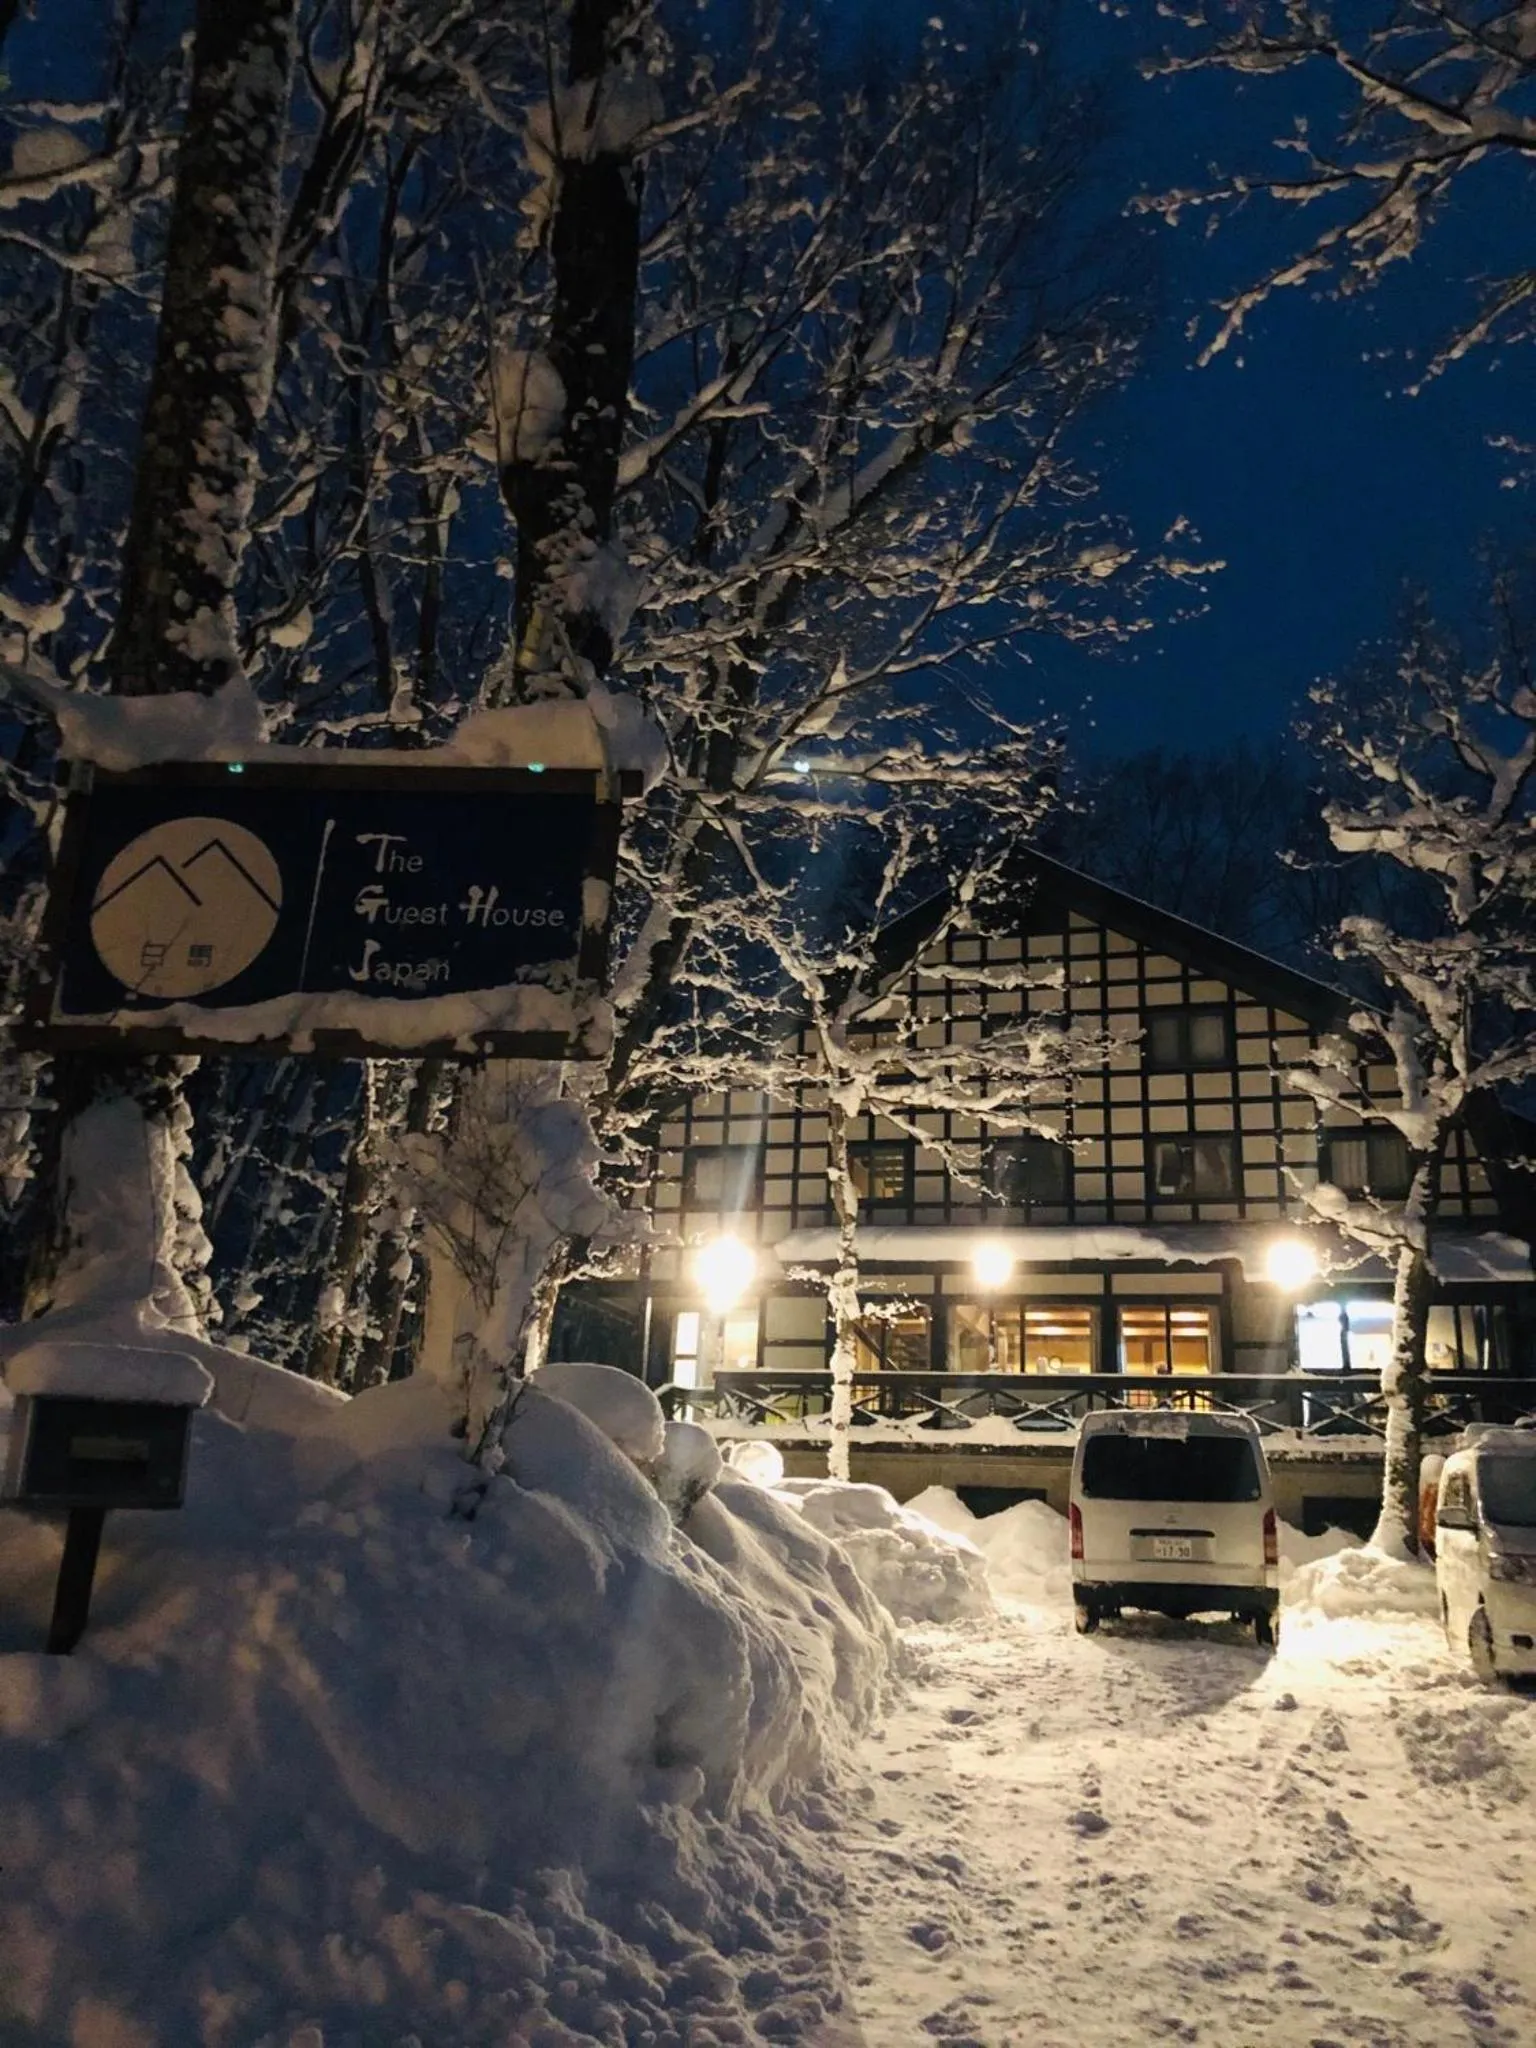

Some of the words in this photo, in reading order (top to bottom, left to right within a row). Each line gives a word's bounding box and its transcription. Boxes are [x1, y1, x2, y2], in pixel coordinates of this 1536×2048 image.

[356, 833, 423, 873] The
[354, 884, 449, 925] Guest
[459, 884, 565, 927] House
[348, 938, 449, 986] Japan
